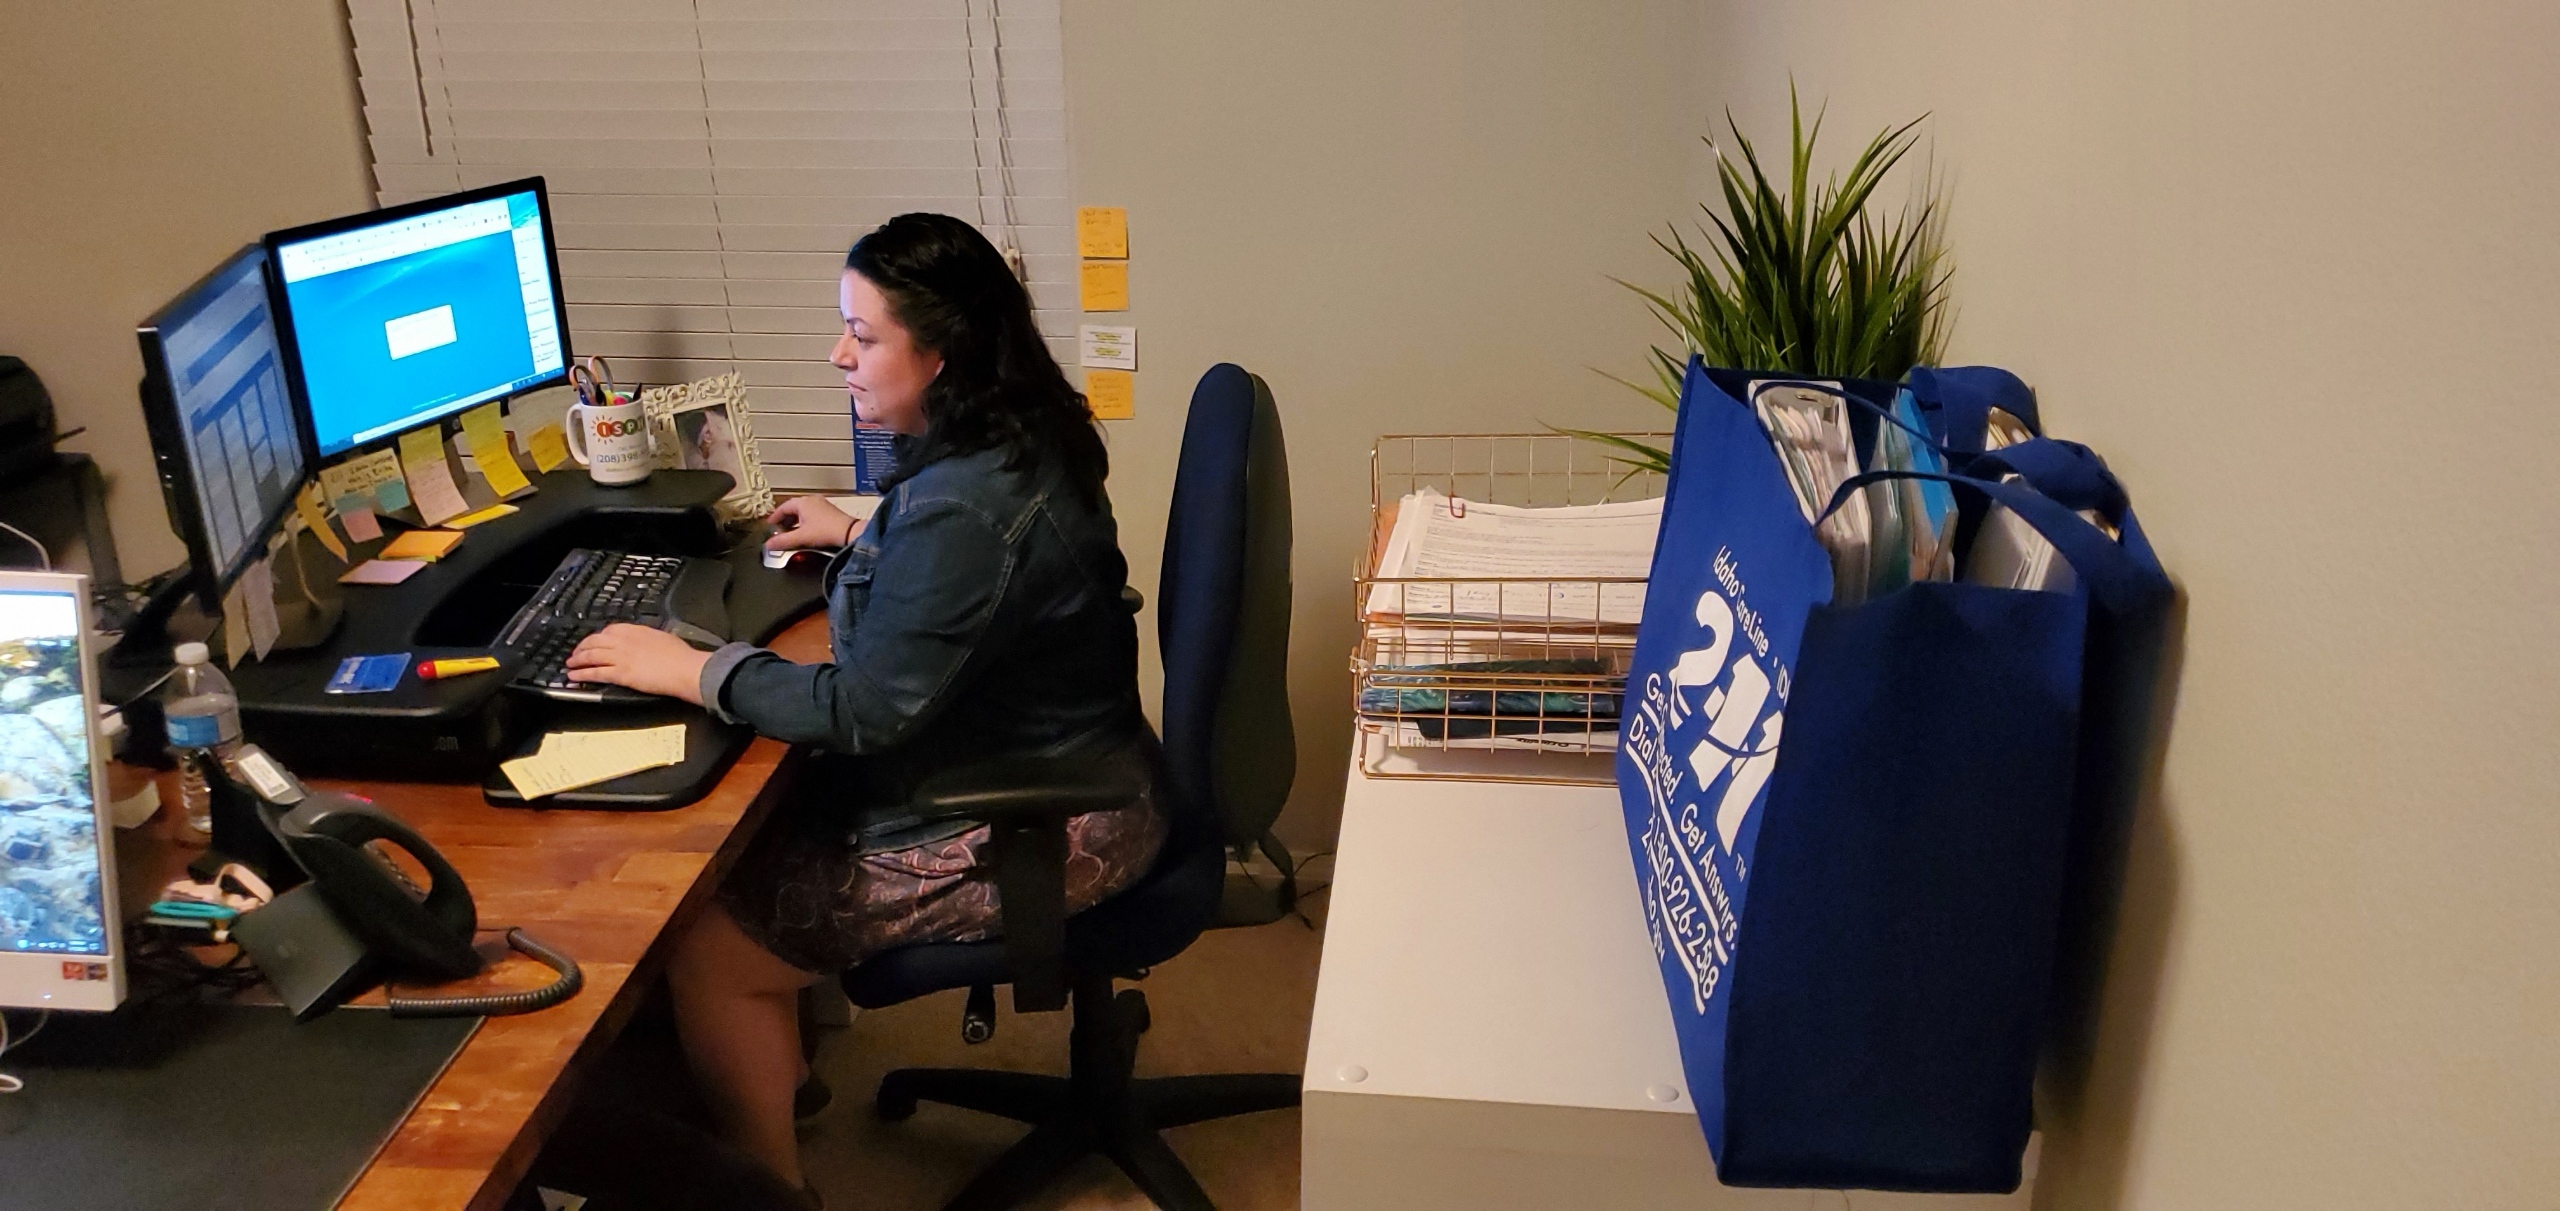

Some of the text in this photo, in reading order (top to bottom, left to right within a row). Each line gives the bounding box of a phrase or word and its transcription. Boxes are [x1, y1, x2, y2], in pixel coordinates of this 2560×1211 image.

[1713, 545, 1791, 706] Idaho CareLine ID
[1628, 712, 1658, 766] Dial
[1680, 803, 1707, 855] Get
